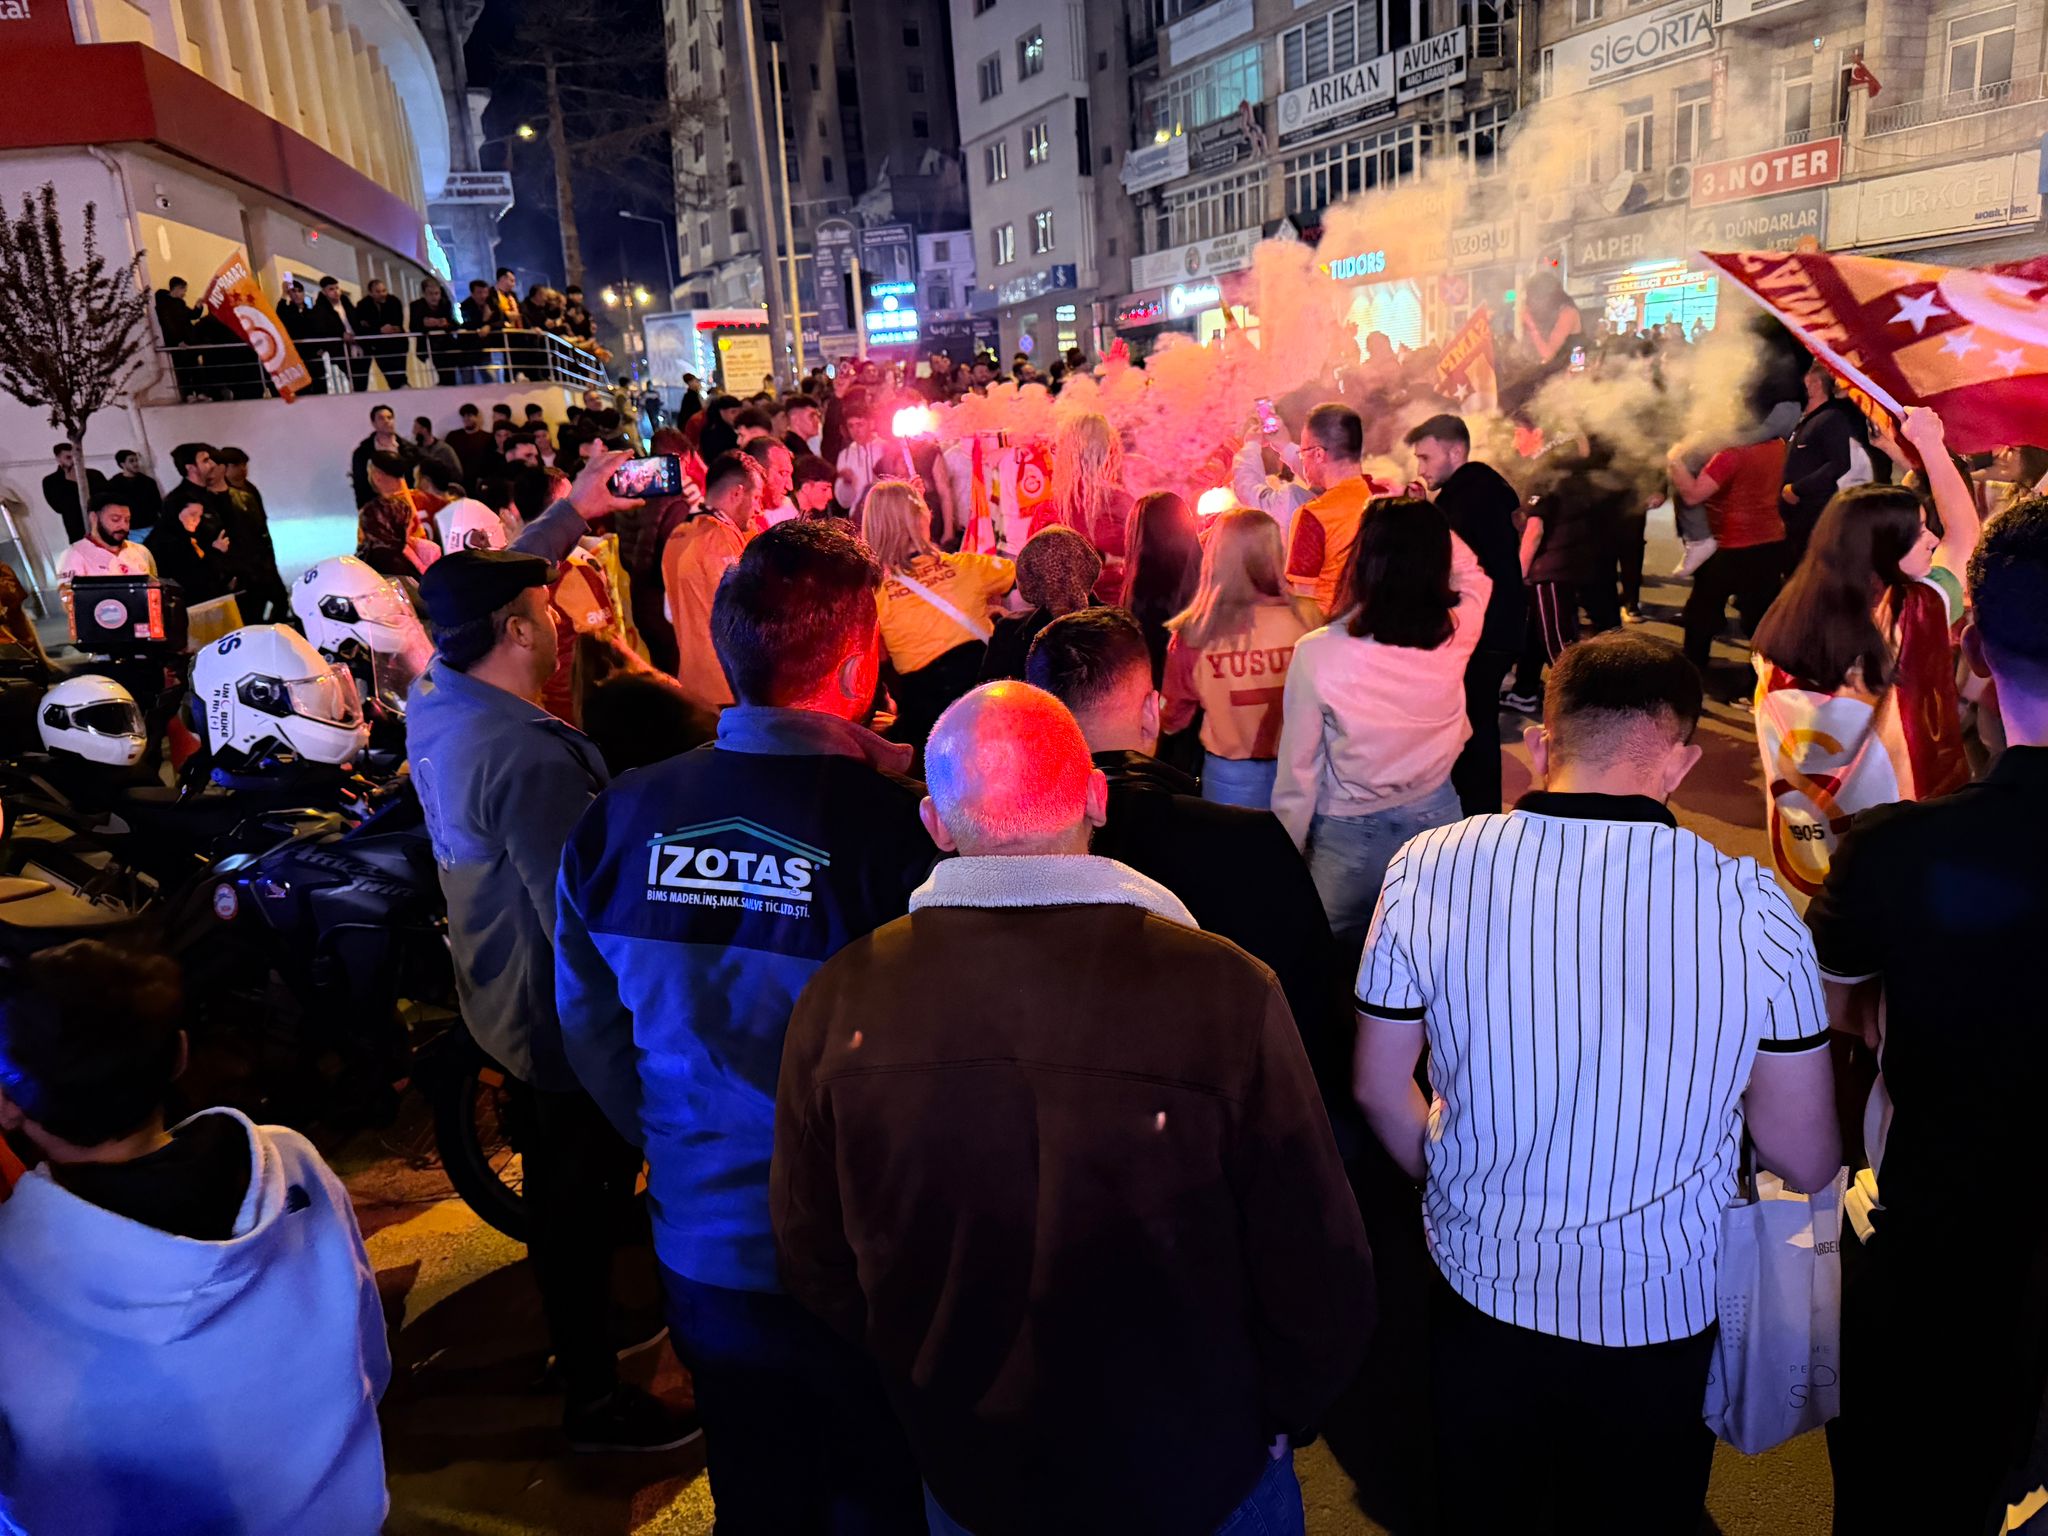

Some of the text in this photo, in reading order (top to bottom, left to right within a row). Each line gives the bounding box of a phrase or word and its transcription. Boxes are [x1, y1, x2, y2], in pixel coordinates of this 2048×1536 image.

[1402, 31, 1459, 74] AVUKAT
[1590, 9, 1716, 73] SİGORTA
[1307, 62, 1381, 114] ARIKAN
[1725, 207, 1818, 239] DÜNDARLAR
[1582, 233, 1645, 264] ALPER
[1329, 250, 1386, 281] TUDORS
[647, 888, 668, 902] BİMS
